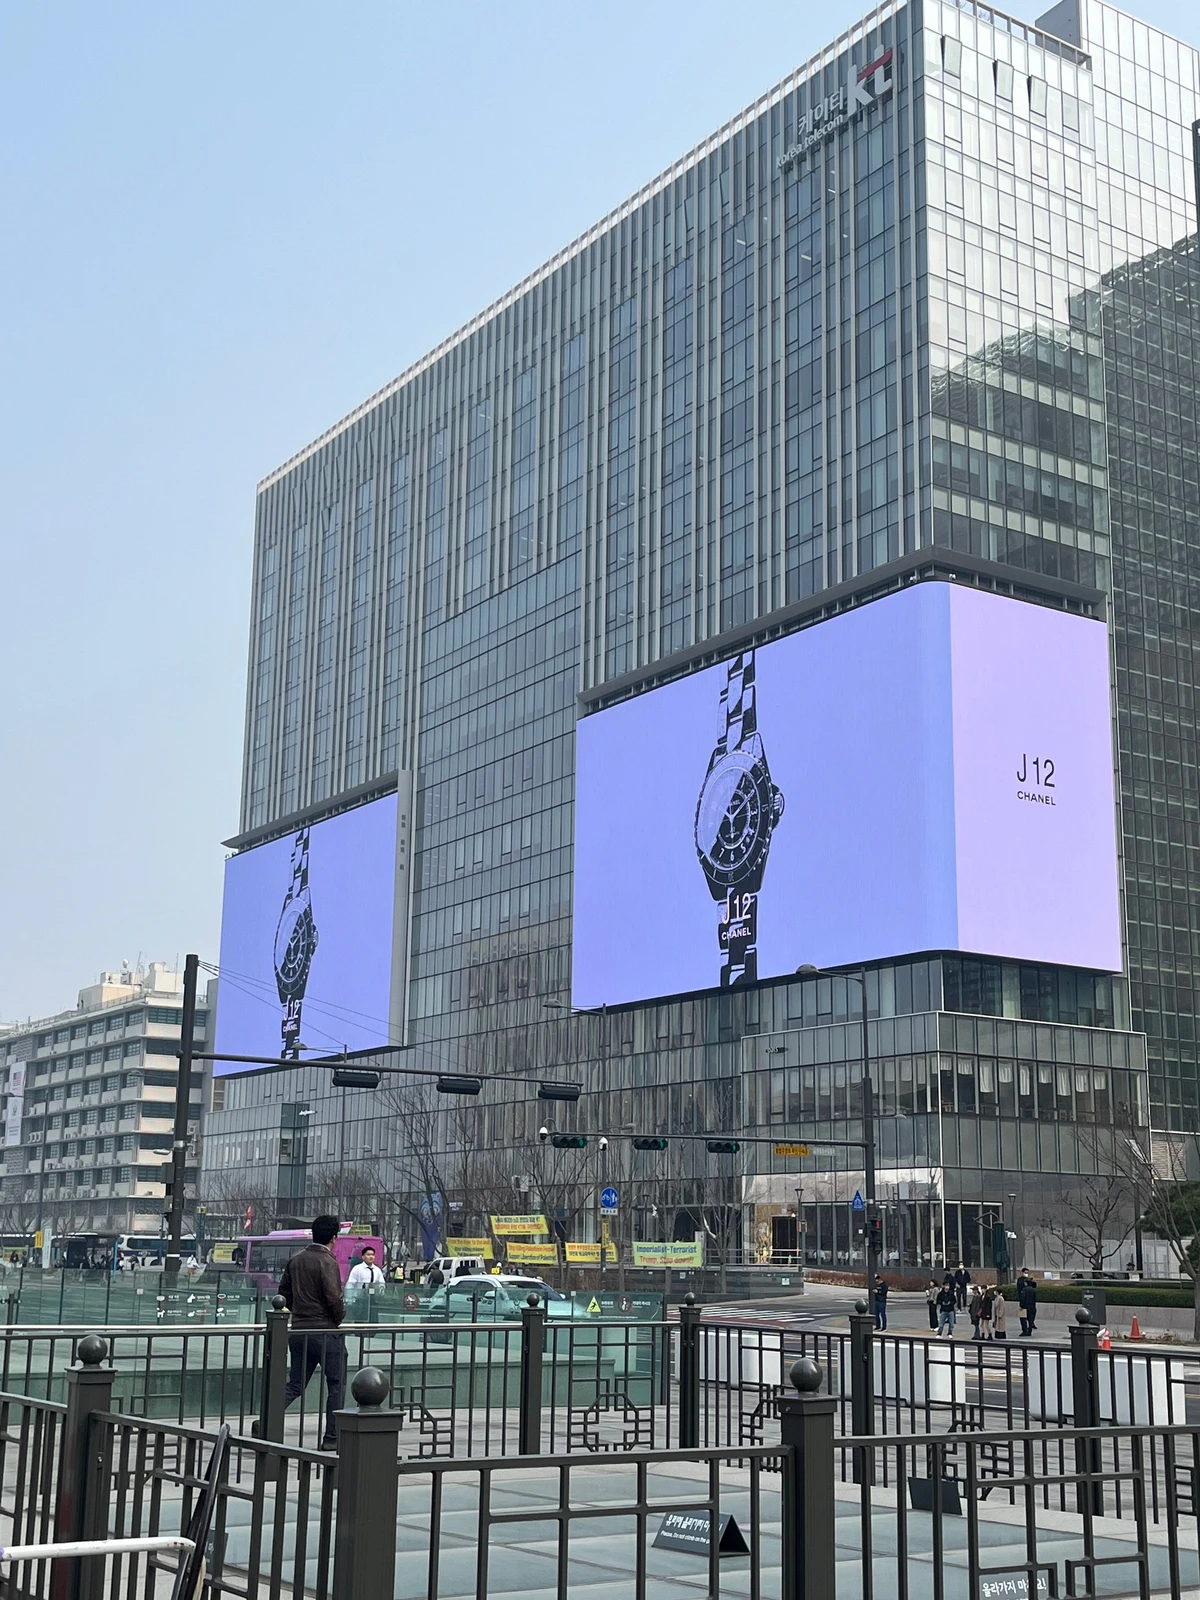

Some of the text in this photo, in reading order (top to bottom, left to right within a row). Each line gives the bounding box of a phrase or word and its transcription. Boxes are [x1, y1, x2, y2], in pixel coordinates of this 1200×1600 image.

[847, 44, 893, 118] kt
[798, 86, 844, 135] 케이티
[804, 113, 844, 148] telecom
[1016, 753, 1056, 788] J12
[1016, 790, 1057, 806] CHANEL
[721, 892, 752, 925] J12
[721, 926, 752, 941] CHANEL
[636, 1245, 697, 1254] Imperialist-Terrorist
[982, 1579, 1017, 1598] 올라가지
